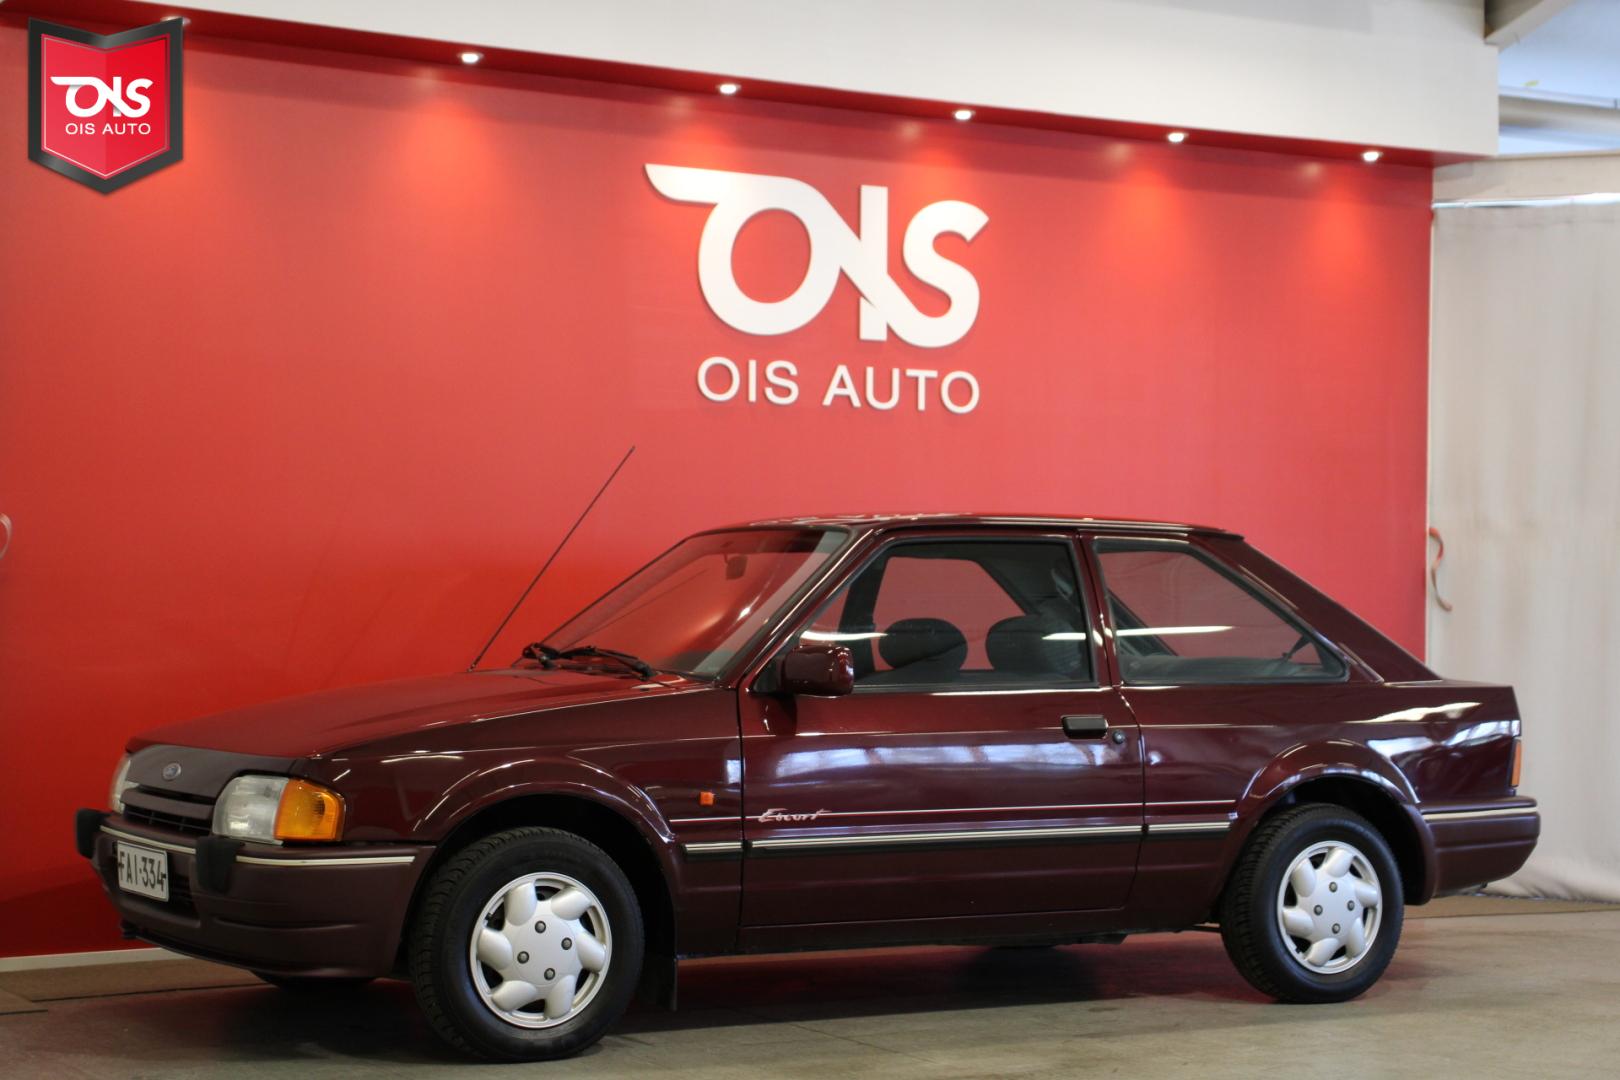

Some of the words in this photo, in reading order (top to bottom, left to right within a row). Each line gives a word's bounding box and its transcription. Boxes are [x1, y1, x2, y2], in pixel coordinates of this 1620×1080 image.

[697, 356, 799, 405] OIS
[822, 364, 980, 414] AUTO
[118, 851, 167, 891] FAI-334
